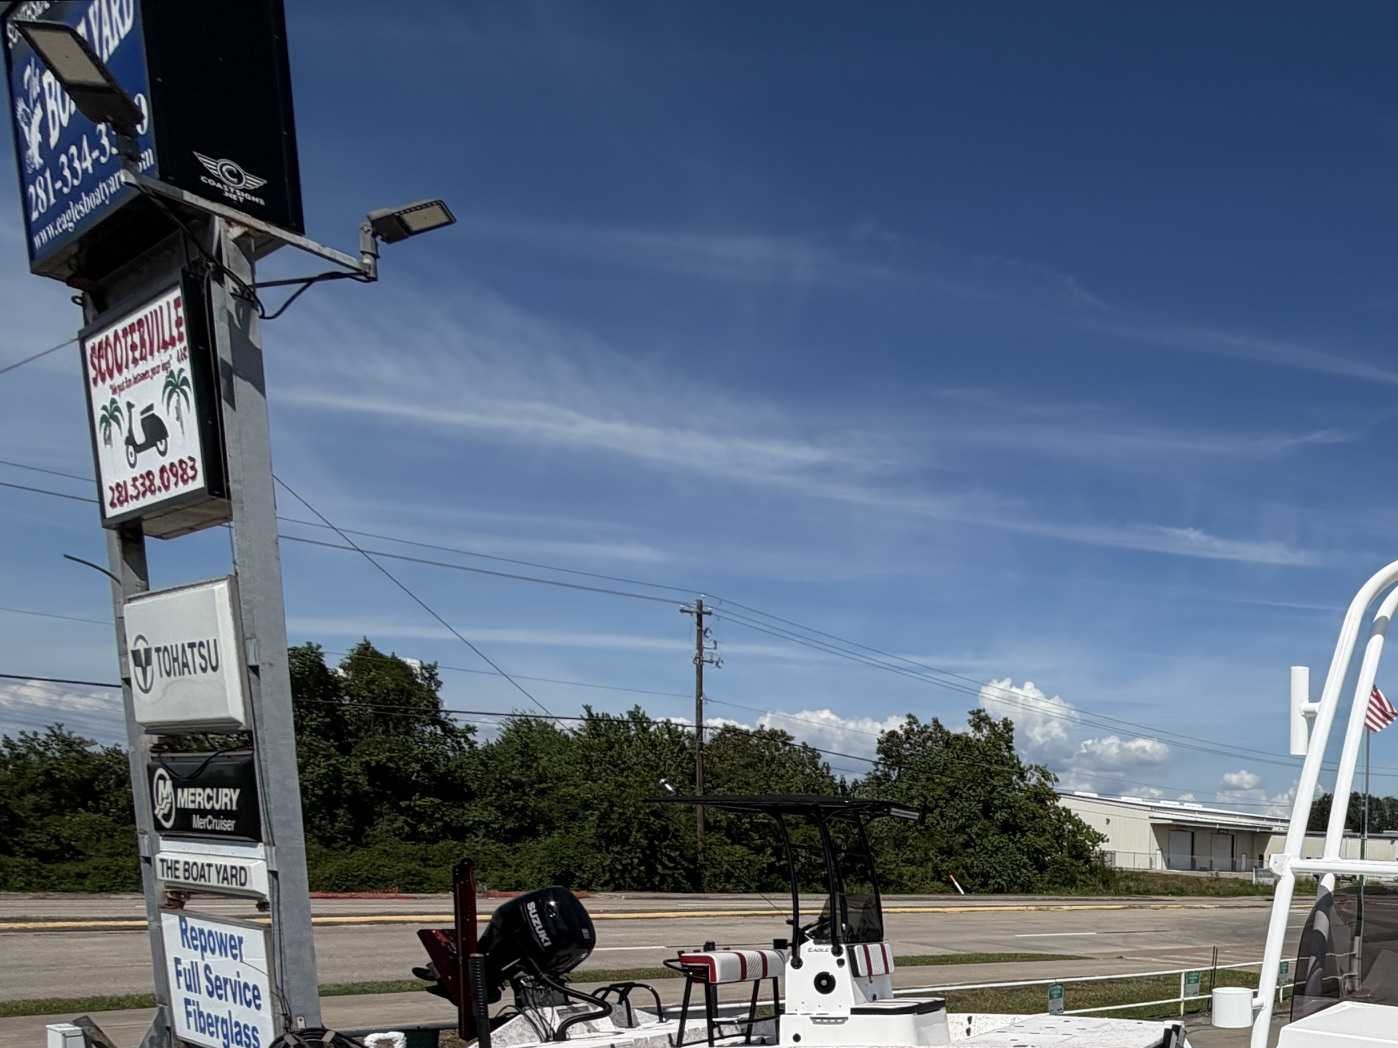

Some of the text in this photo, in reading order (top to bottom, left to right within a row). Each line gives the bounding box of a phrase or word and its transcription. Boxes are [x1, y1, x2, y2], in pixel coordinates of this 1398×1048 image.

[90, 296, 184, 388] SCOOTERVILLE
[108, 455, 199, 509] 281.538.0983
[154, 638, 220, 679] TOHATSU
[176, 787, 241, 811] MERCURY
[191, 813, 237, 832] MerCruiser
[159, 858, 248, 887] THE BOAT YARD
[179, 916, 244, 963] Repower
[527, 902, 552, 947] SUZUKI
[174, 956, 262, 1011] Full Service
